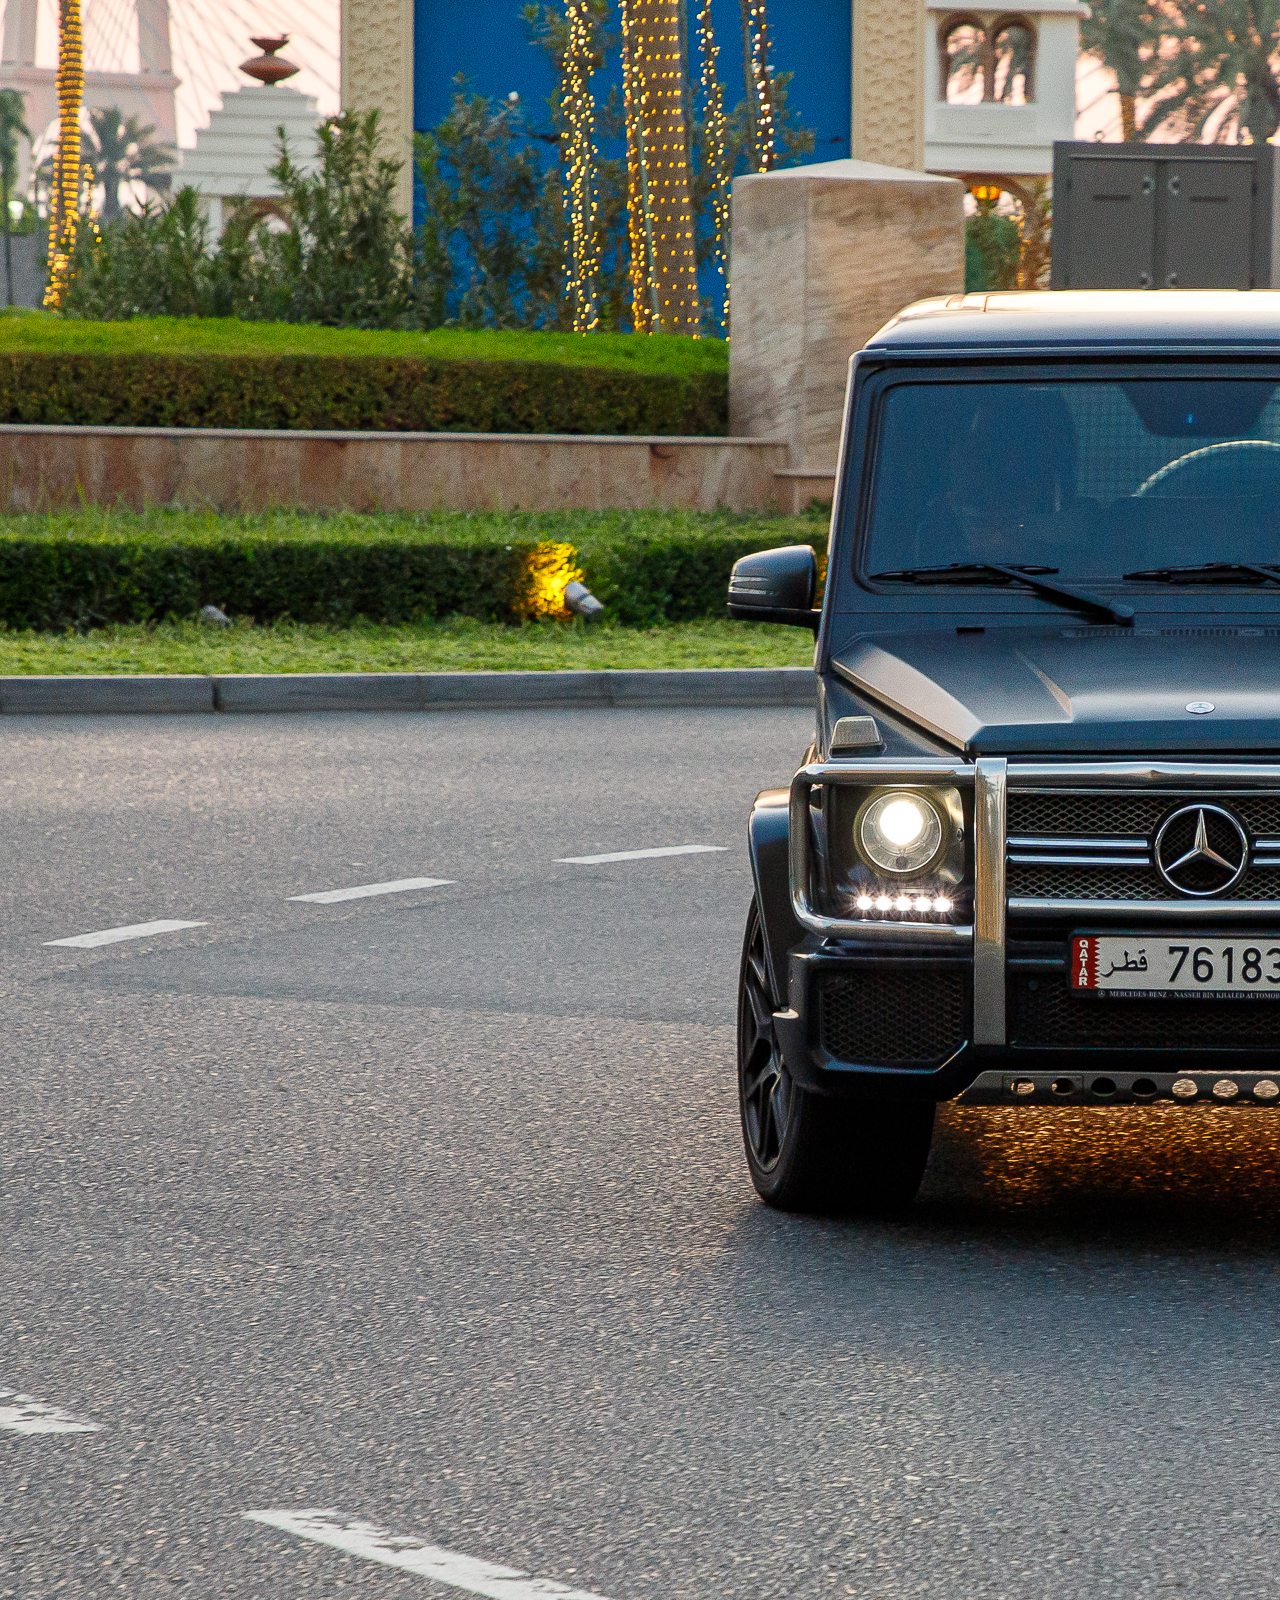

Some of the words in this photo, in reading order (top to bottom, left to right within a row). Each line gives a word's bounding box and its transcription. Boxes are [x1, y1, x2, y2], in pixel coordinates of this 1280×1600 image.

[1078, 939, 1089, 986] QATAR
[1100, 948, 1148, 978] قطر
[1109, 990, 1167, 998] MERCEDES-BENZ
[1174, 991, 1201, 999] NASSER
